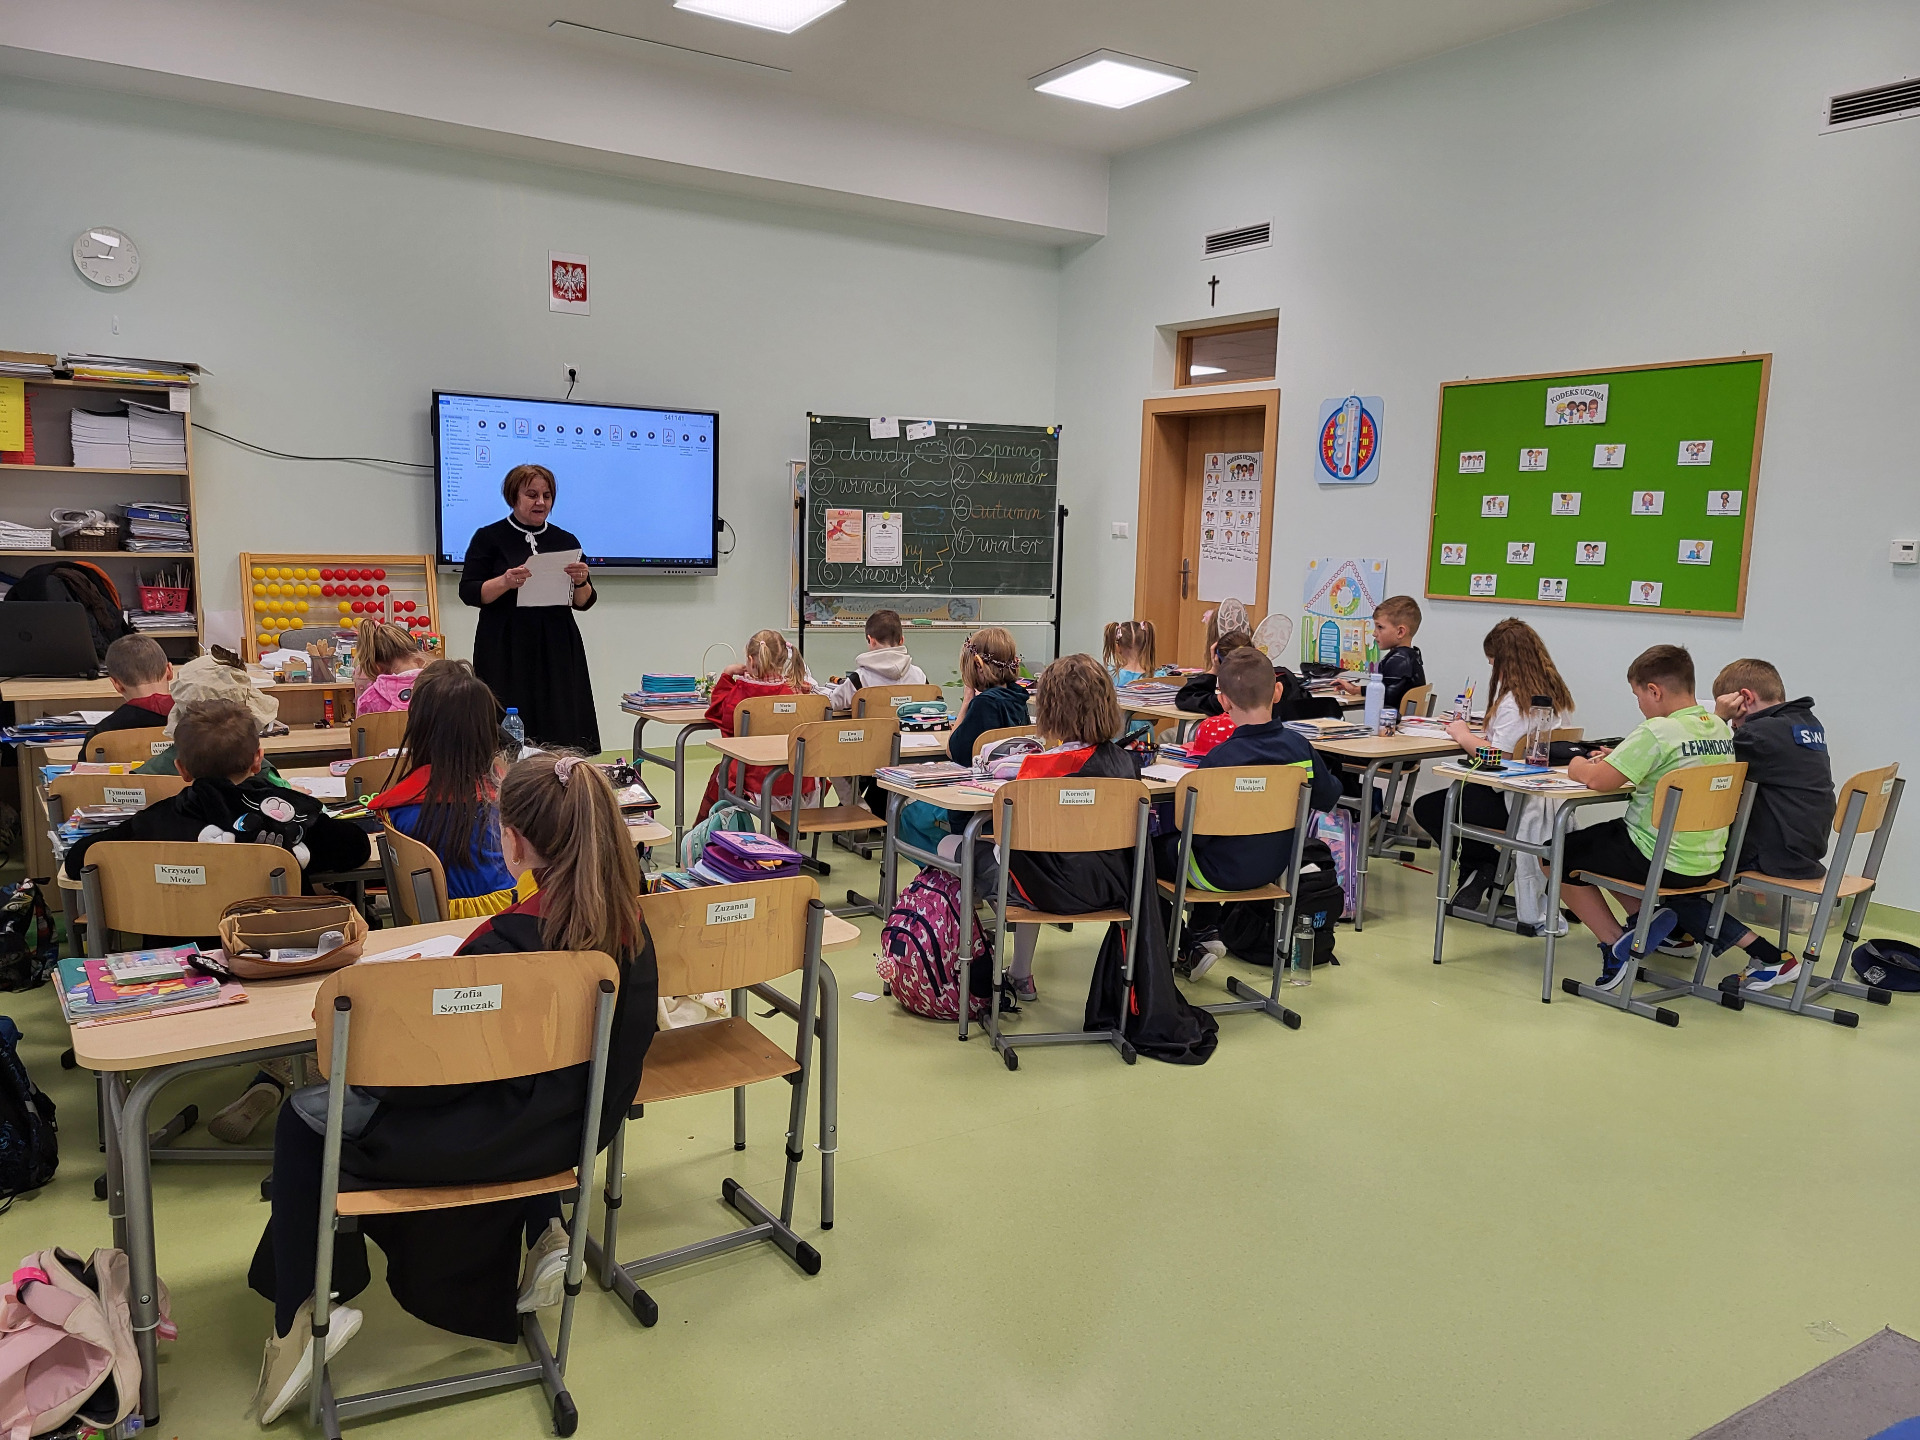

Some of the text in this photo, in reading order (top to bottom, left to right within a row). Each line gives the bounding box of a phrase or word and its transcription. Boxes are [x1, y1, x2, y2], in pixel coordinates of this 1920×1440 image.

[80, 240, 90, 248] 10
[126, 244, 133, 253] 2
[82, 261, 88, 269] 8
[131, 255, 138, 265] 3
[92, 270, 99, 279] 7
[104, 275, 112, 284] 6
[118, 273, 125, 282] 5
[1550, 388, 1605, 404] KODEKS UCZNIA
[839, 436, 915, 478] cloudy
[979, 442, 1044, 473] spring
[977, 469, 1048, 484] summer
[838, 472, 902, 508] windy
[971, 500, 1046, 520] autumn
[977, 529, 1044, 555] winter
[849, 565, 911, 592] snowy
[106, 789, 142, 797] Tymoteusz
[161, 866, 200, 875] Krzysztof
[170, 875, 192, 883] Mróz
[714, 902, 749, 912] Zuzanna
[715, 912, 748, 922] Pisarska
[453, 989, 482, 1000] Zofia
[440, 1000, 495, 1014] Szymczak
